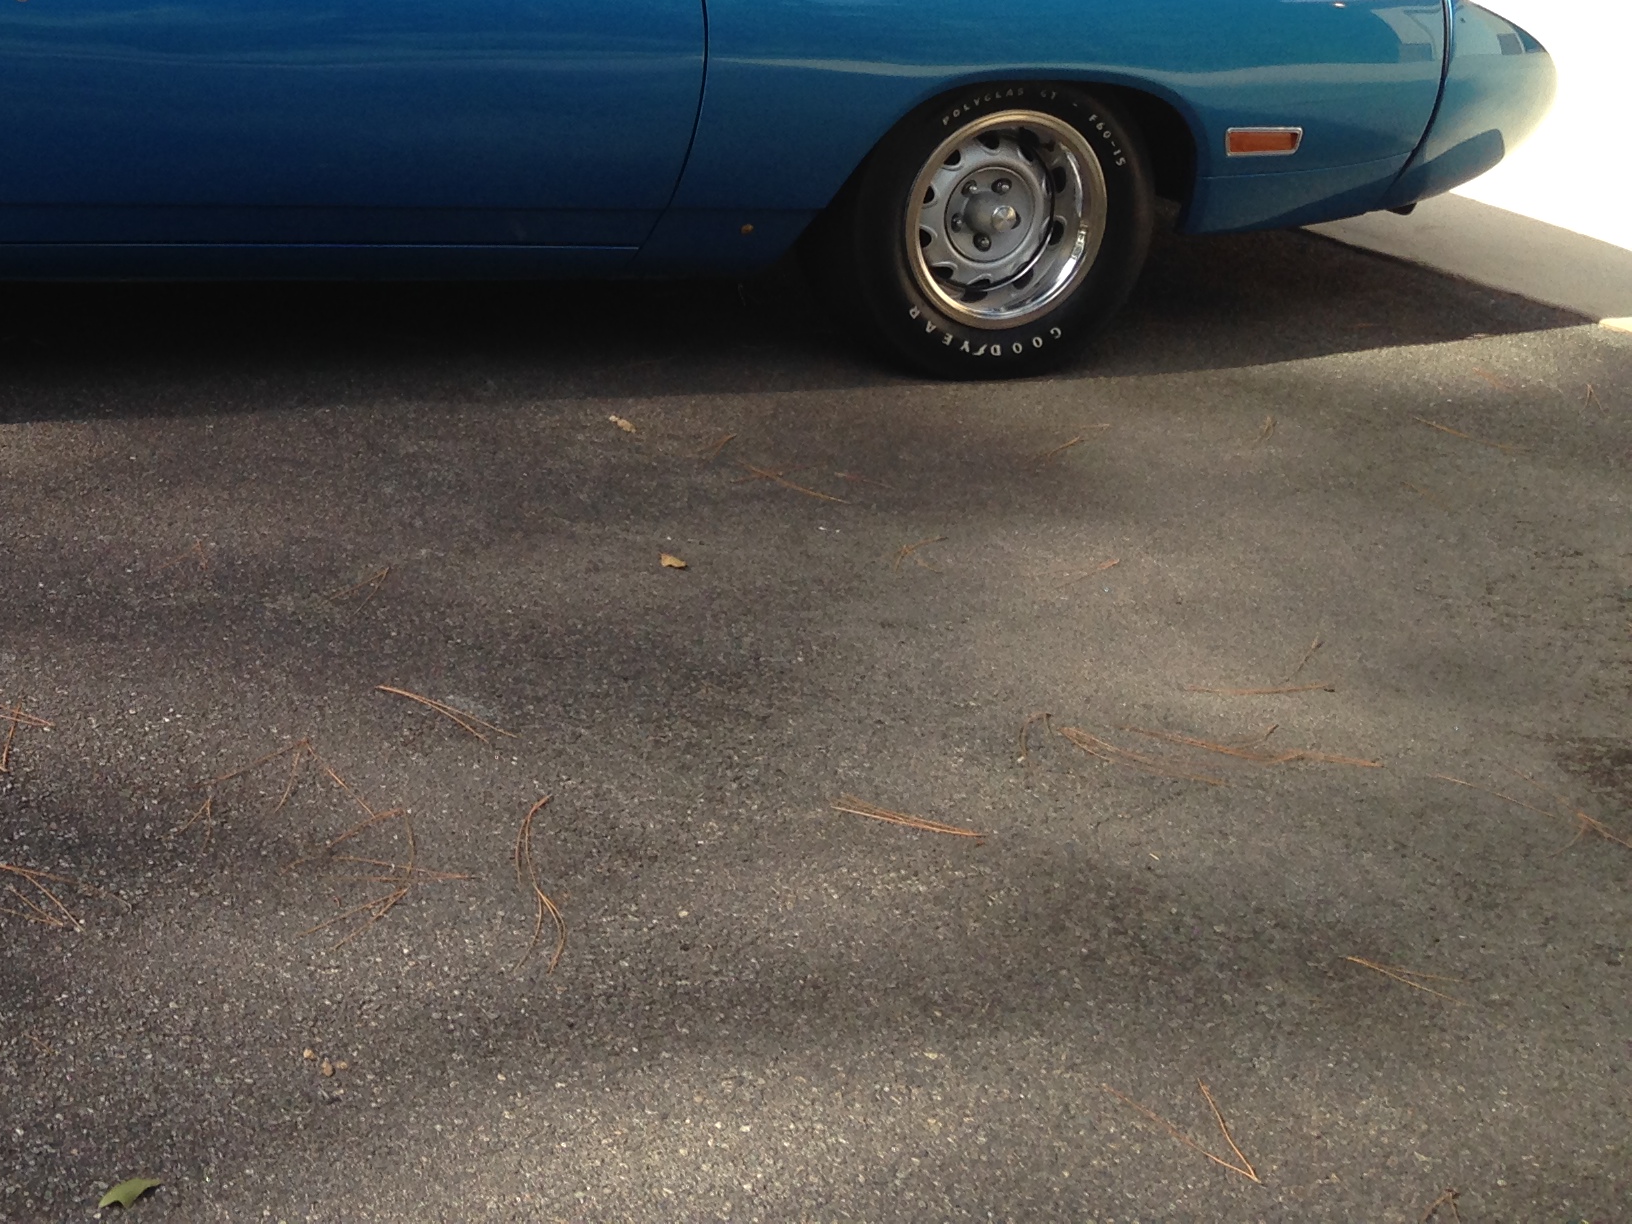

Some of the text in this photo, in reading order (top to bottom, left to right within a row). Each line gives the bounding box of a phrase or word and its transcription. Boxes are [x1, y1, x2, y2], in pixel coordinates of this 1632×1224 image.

[941, 87, 1025, 126] POLYGLAS
[1088, 113, 1127, 167] F60-15
[909, 305, 1061, 357] GOODYEAR
